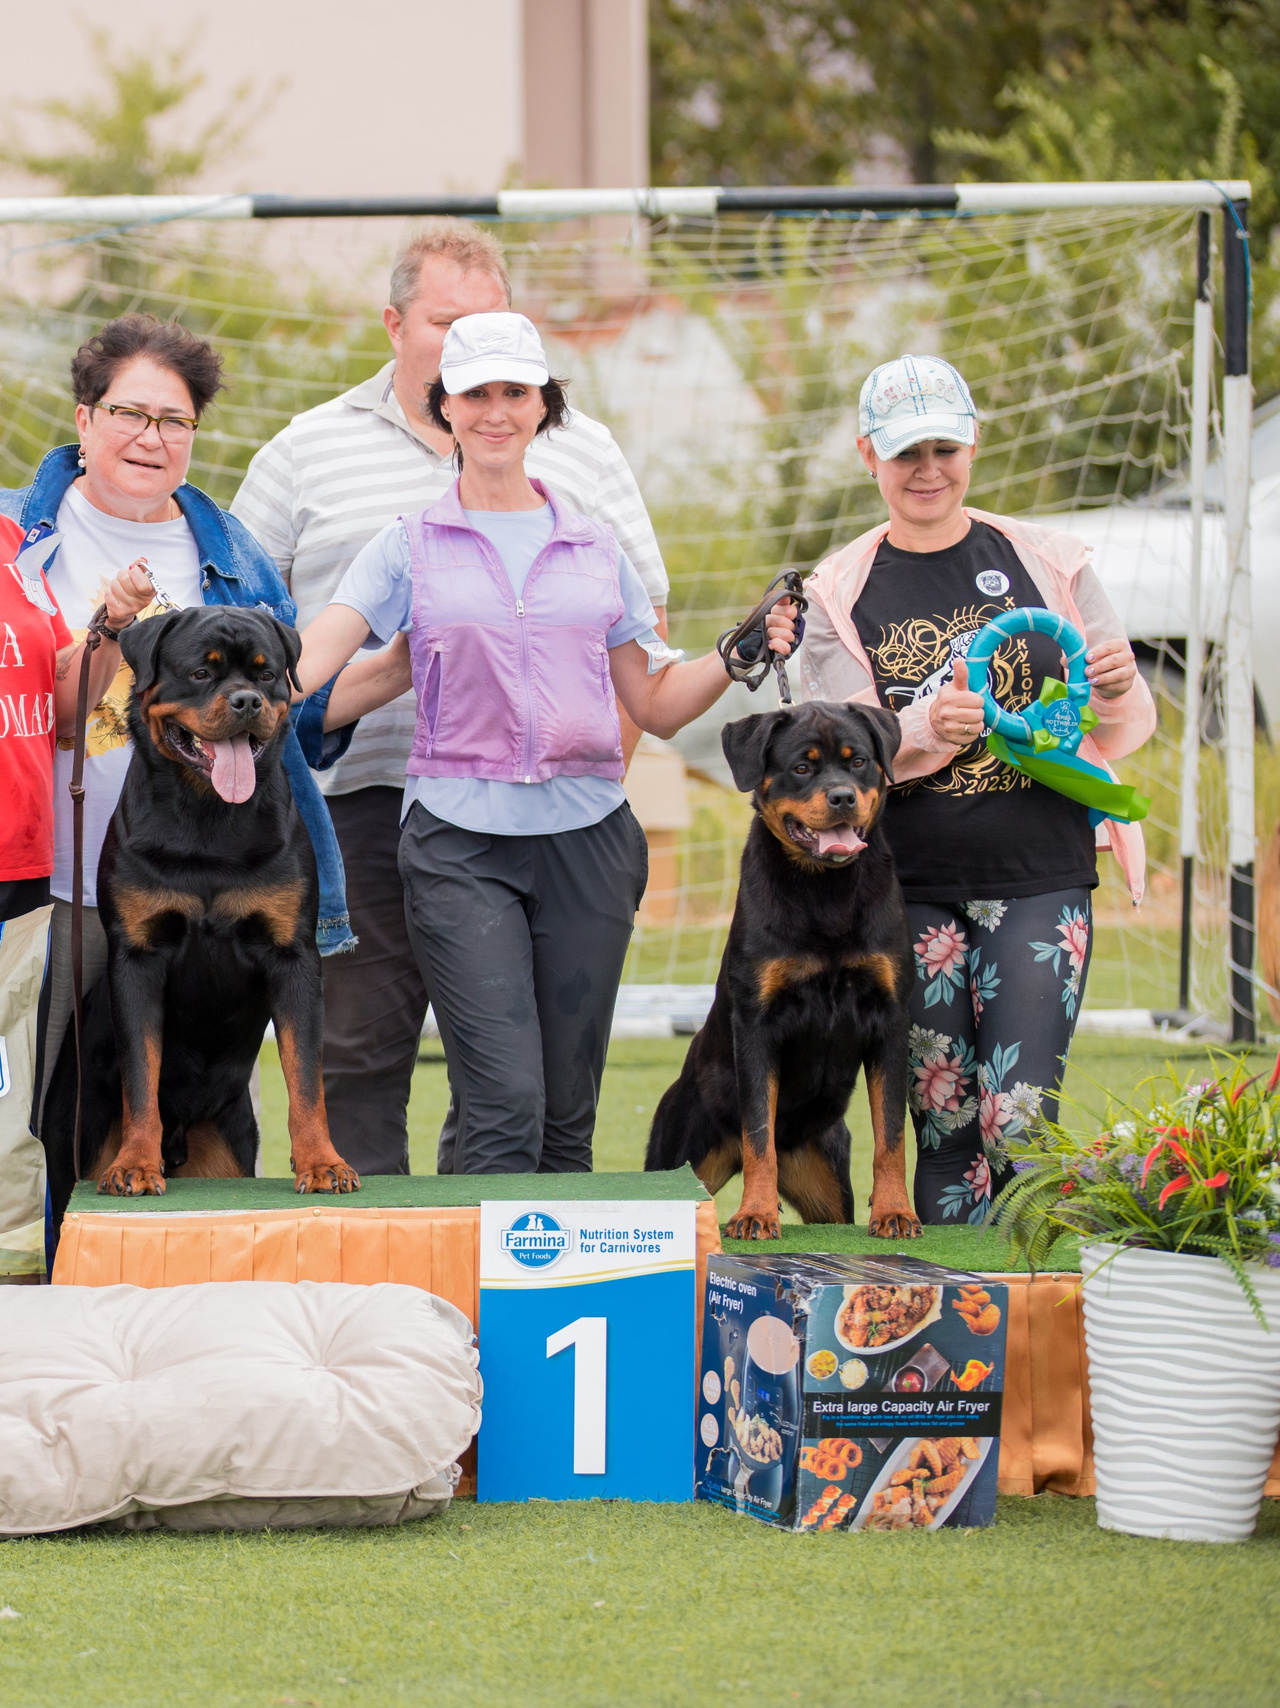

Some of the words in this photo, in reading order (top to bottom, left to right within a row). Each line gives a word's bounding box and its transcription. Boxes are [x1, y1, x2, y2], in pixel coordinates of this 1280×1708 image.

[0, 622, 25, 668] A
[1017, 639, 1033, 704] КУБОК
[964, 774, 1012, 794] 2023
[506, 1232, 565, 1247] Farmina
[580, 1228, 629, 1240] Nutrition
[633, 1228, 674, 1242] System
[580, 1242, 595, 1253] for
[600, 1242, 661, 1253] Carnivores
[709, 1272, 737, 1291] Electric
[738, 1282, 757, 1297] oven
[709, 1290, 721, 1305] (Air
[723, 1294, 743, 1314] Fryer)
[546, 1317, 607, 1474] 1
[813, 1401, 843, 1412] Extra
[848, 1401, 878, 1415] large
[882, 1401, 934, 1414] Capacity
[936, 1401, 954, 1412] Air
[958, 1401, 990, 1414] Fryer
